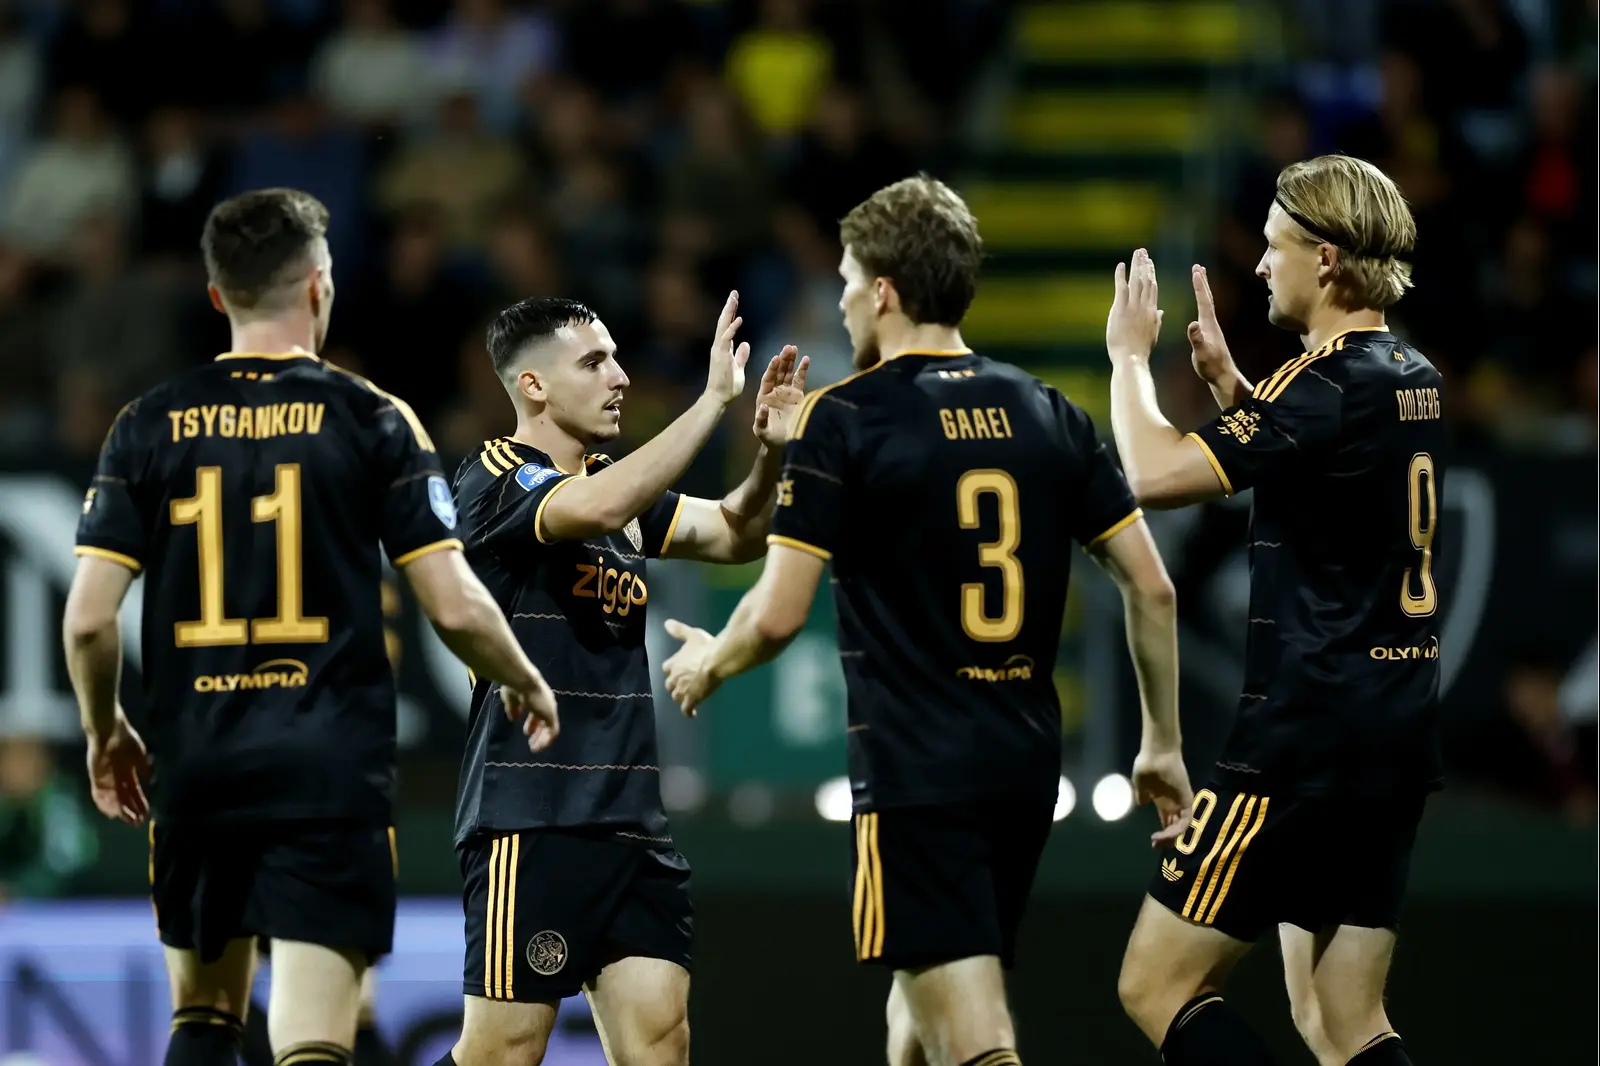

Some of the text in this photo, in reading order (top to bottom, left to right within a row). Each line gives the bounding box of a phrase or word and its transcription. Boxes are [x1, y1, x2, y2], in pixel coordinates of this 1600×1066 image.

[168, 402, 325, 443] TSYGANKOV
[939, 407, 1013, 440] GAAEI
[1233, 409, 1260, 437] ROCK
[1395, 387, 1440, 421] DOLBERG
[1220, 415, 1251, 444] STARS
[170, 463, 328, 647] 11
[956, 468, 1025, 642] 3
[1400, 452, 1437, 617] 9
[572, 556, 648, 616] ziggo
[193, 669, 308, 693] OLYMPIA
[1174, 788, 1218, 855] 9
